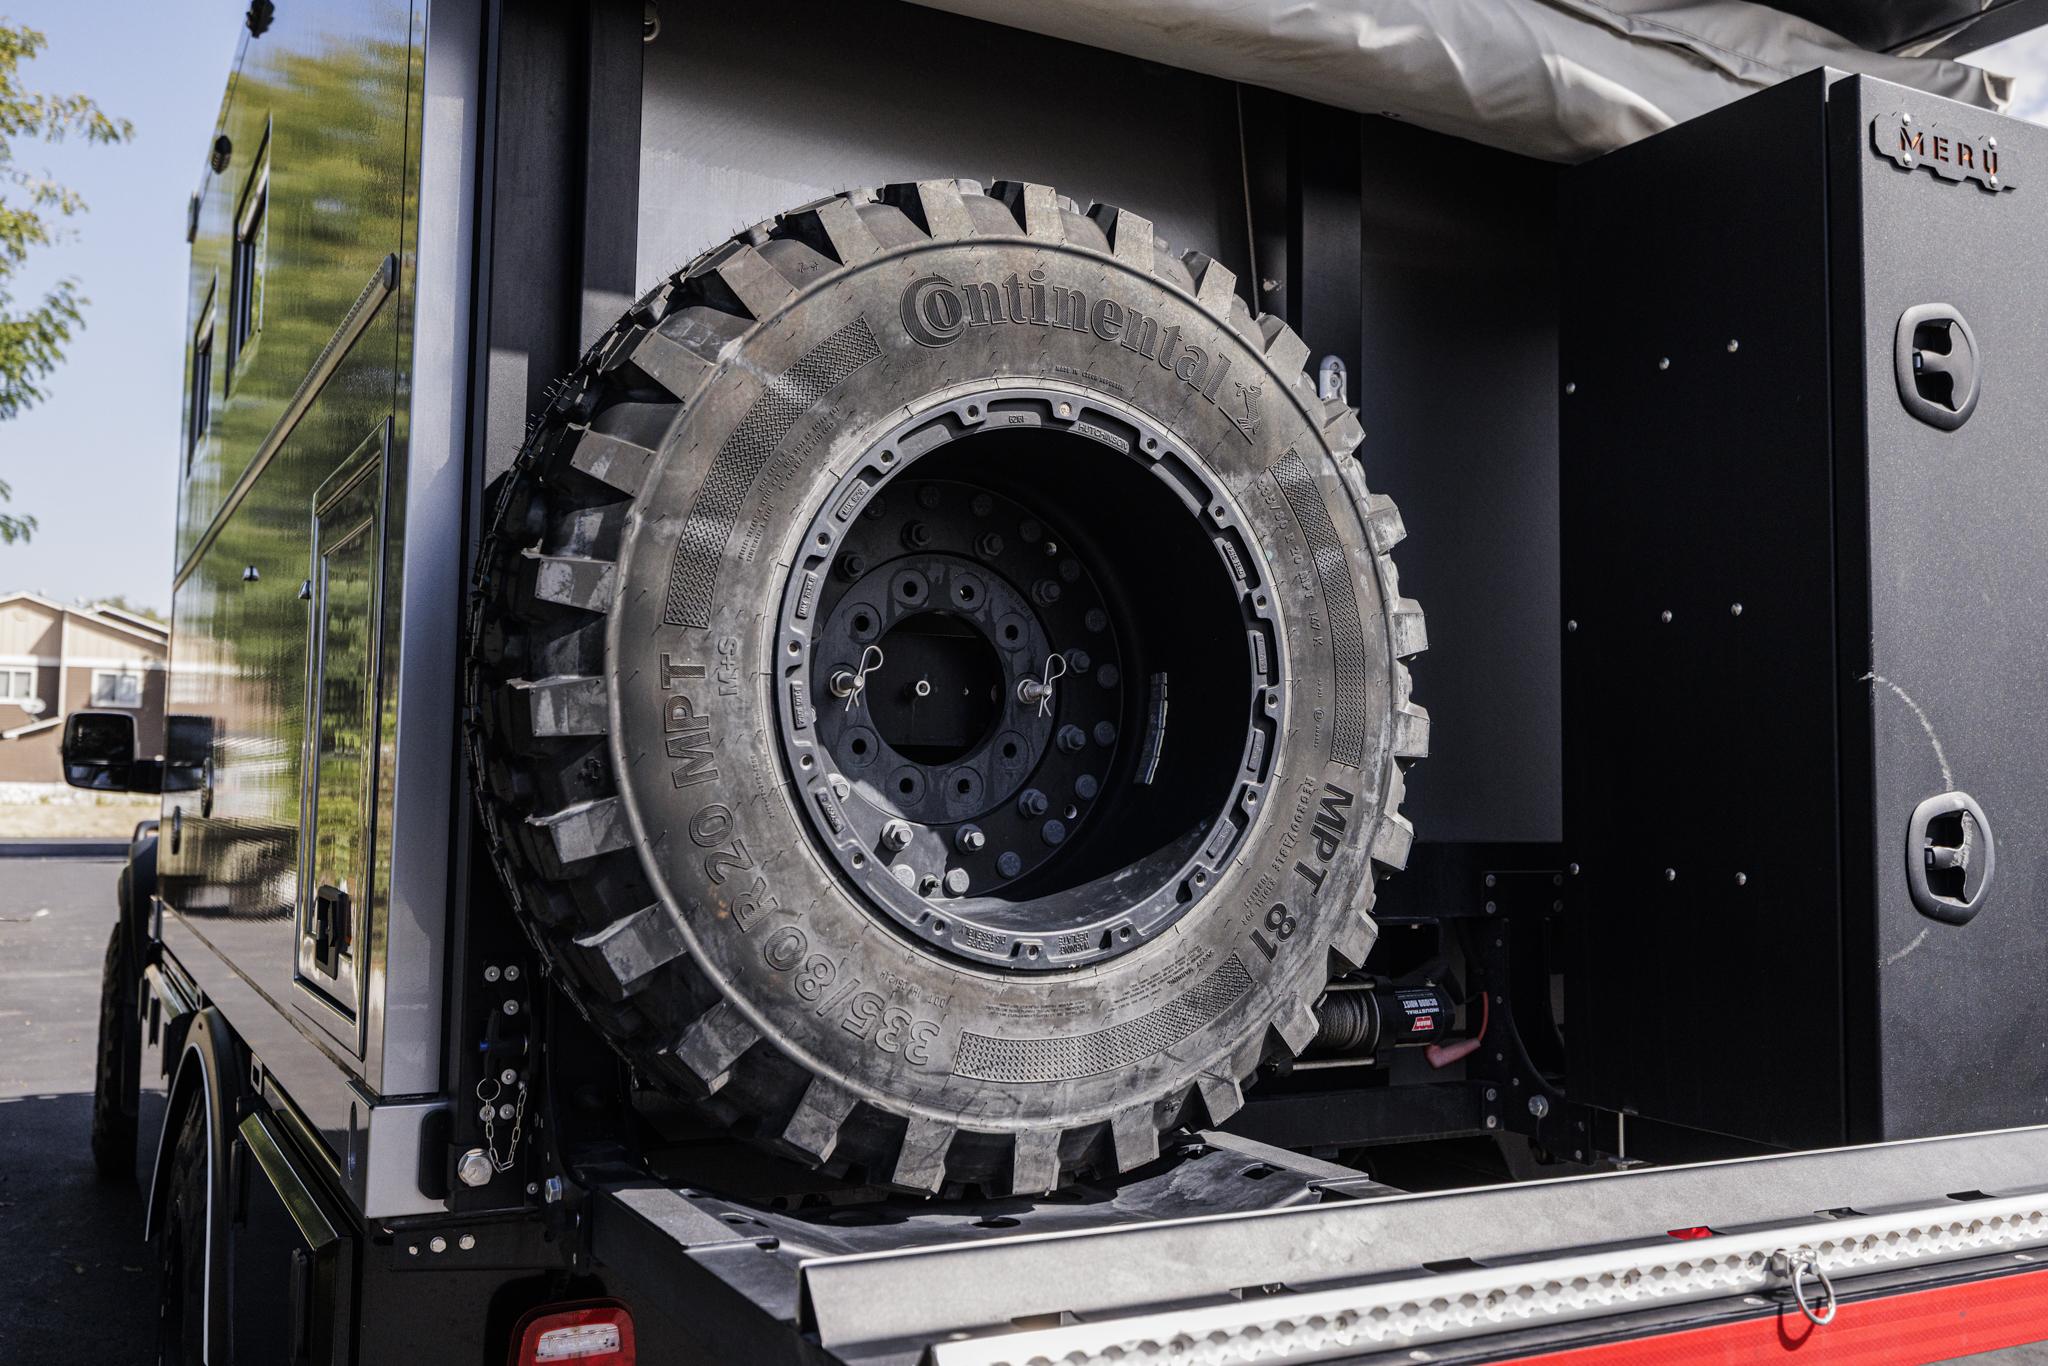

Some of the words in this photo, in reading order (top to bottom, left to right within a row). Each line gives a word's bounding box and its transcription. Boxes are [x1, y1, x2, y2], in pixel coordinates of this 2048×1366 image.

[901, 270, 1232, 403] Continental
[1077, 422, 1129, 451] HUTCHINSON
[717, 636, 739, 696] M+S
[660, 653, 719, 788] MPT
[689, 803, 756, 885] 20
[1294, 783, 1355, 897] MPT
[731, 877, 780, 933] R
[1248, 902, 1297, 963] 81
[763, 925, 940, 1066] 335/80
